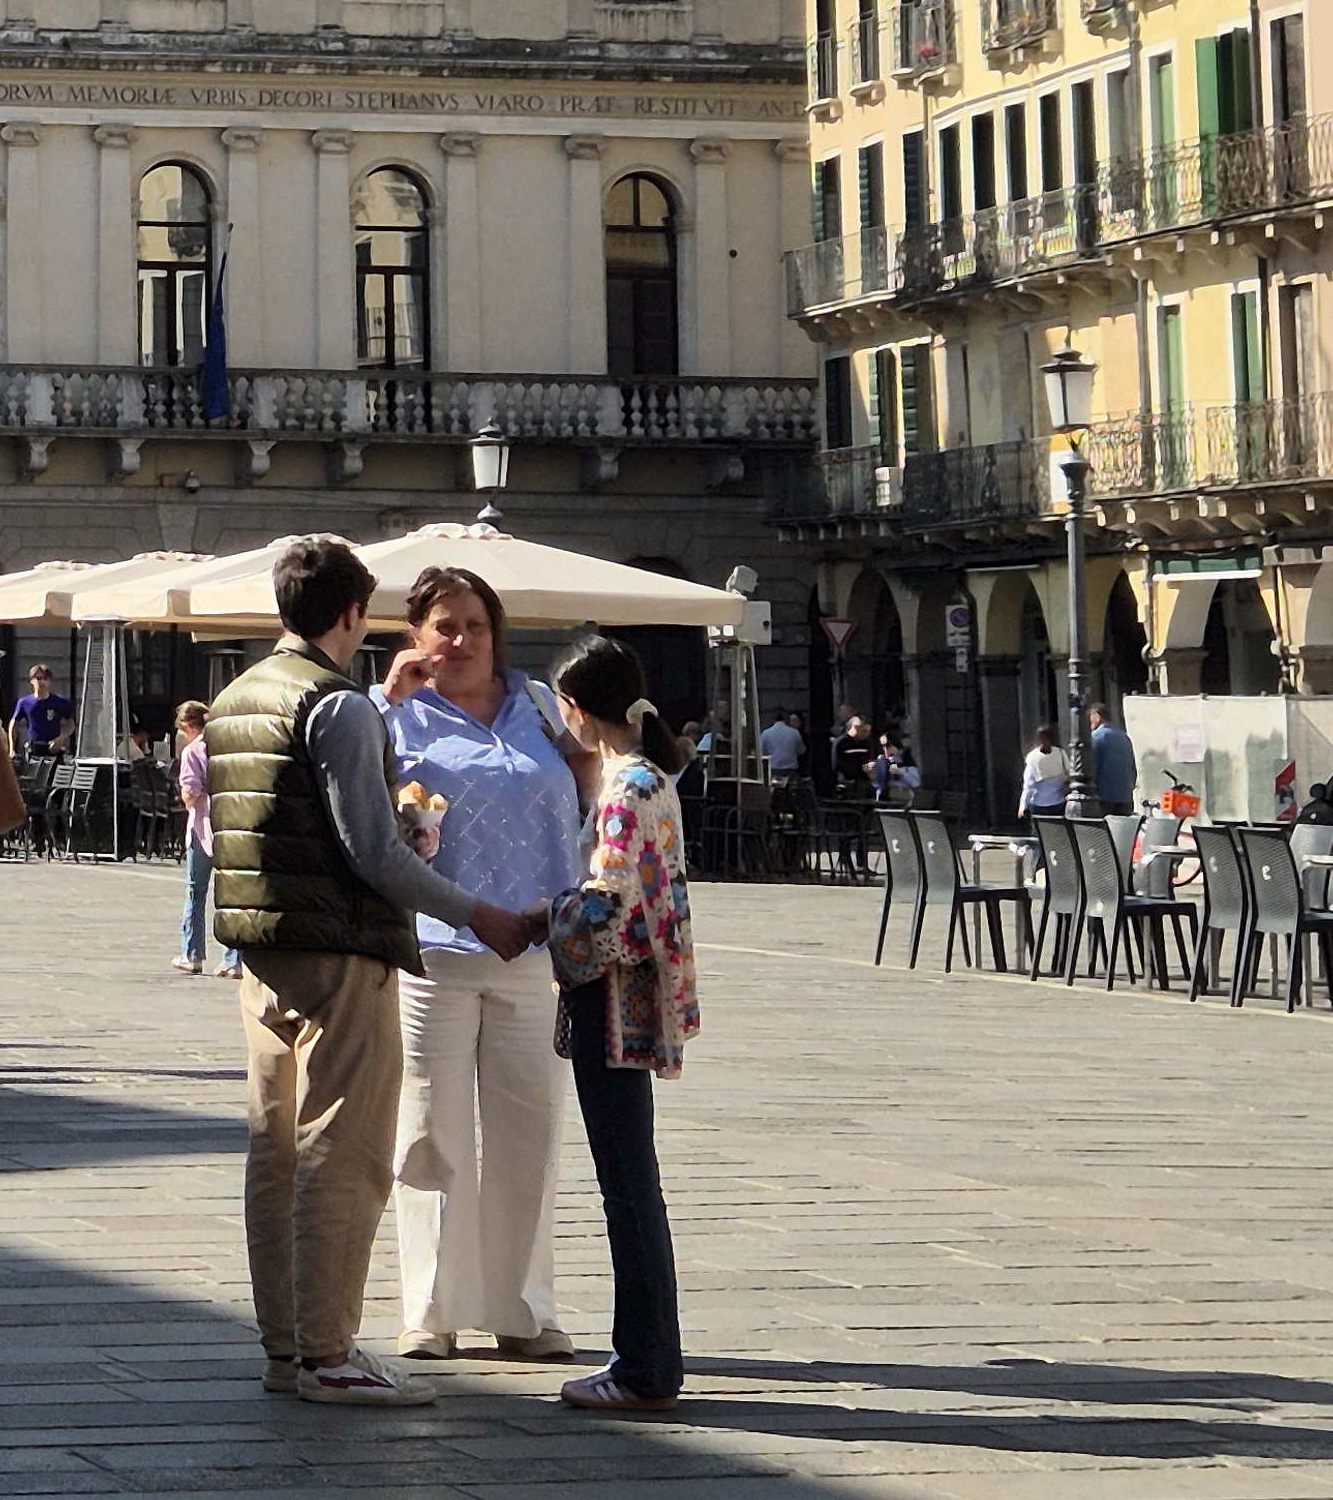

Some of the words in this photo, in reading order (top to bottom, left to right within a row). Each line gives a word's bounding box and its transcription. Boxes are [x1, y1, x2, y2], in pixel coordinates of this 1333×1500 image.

[190, 88, 247, 106] VRBIS
[258, 90, 332, 108] DECORI
[345, 92, 459, 111] STEPHANVS
[475, 94, 544, 112] VIARO
[634, 97, 737, 116] RESTITVIT
